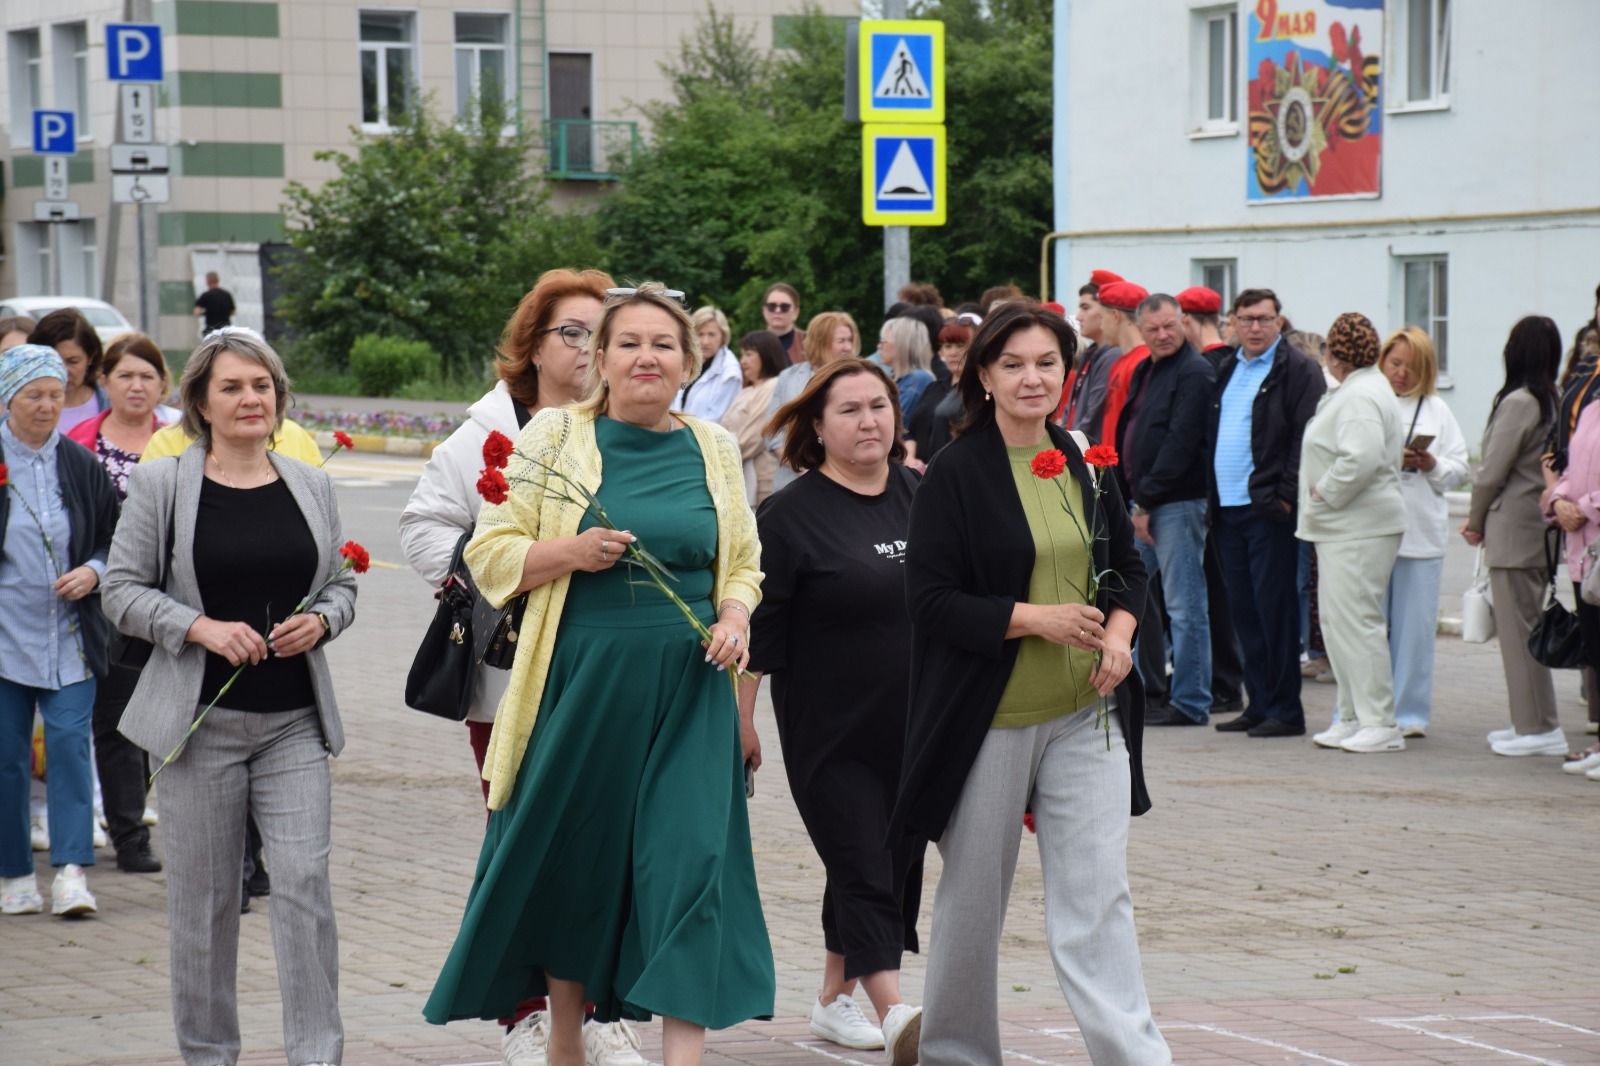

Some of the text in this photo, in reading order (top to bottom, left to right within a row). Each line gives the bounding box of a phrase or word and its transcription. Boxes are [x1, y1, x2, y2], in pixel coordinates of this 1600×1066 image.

[1255, 0, 1316, 40] 9 МАЯ
[117, 29, 151, 76] P
[41, 115, 67, 150] P
[873, 543, 894, 555] My
